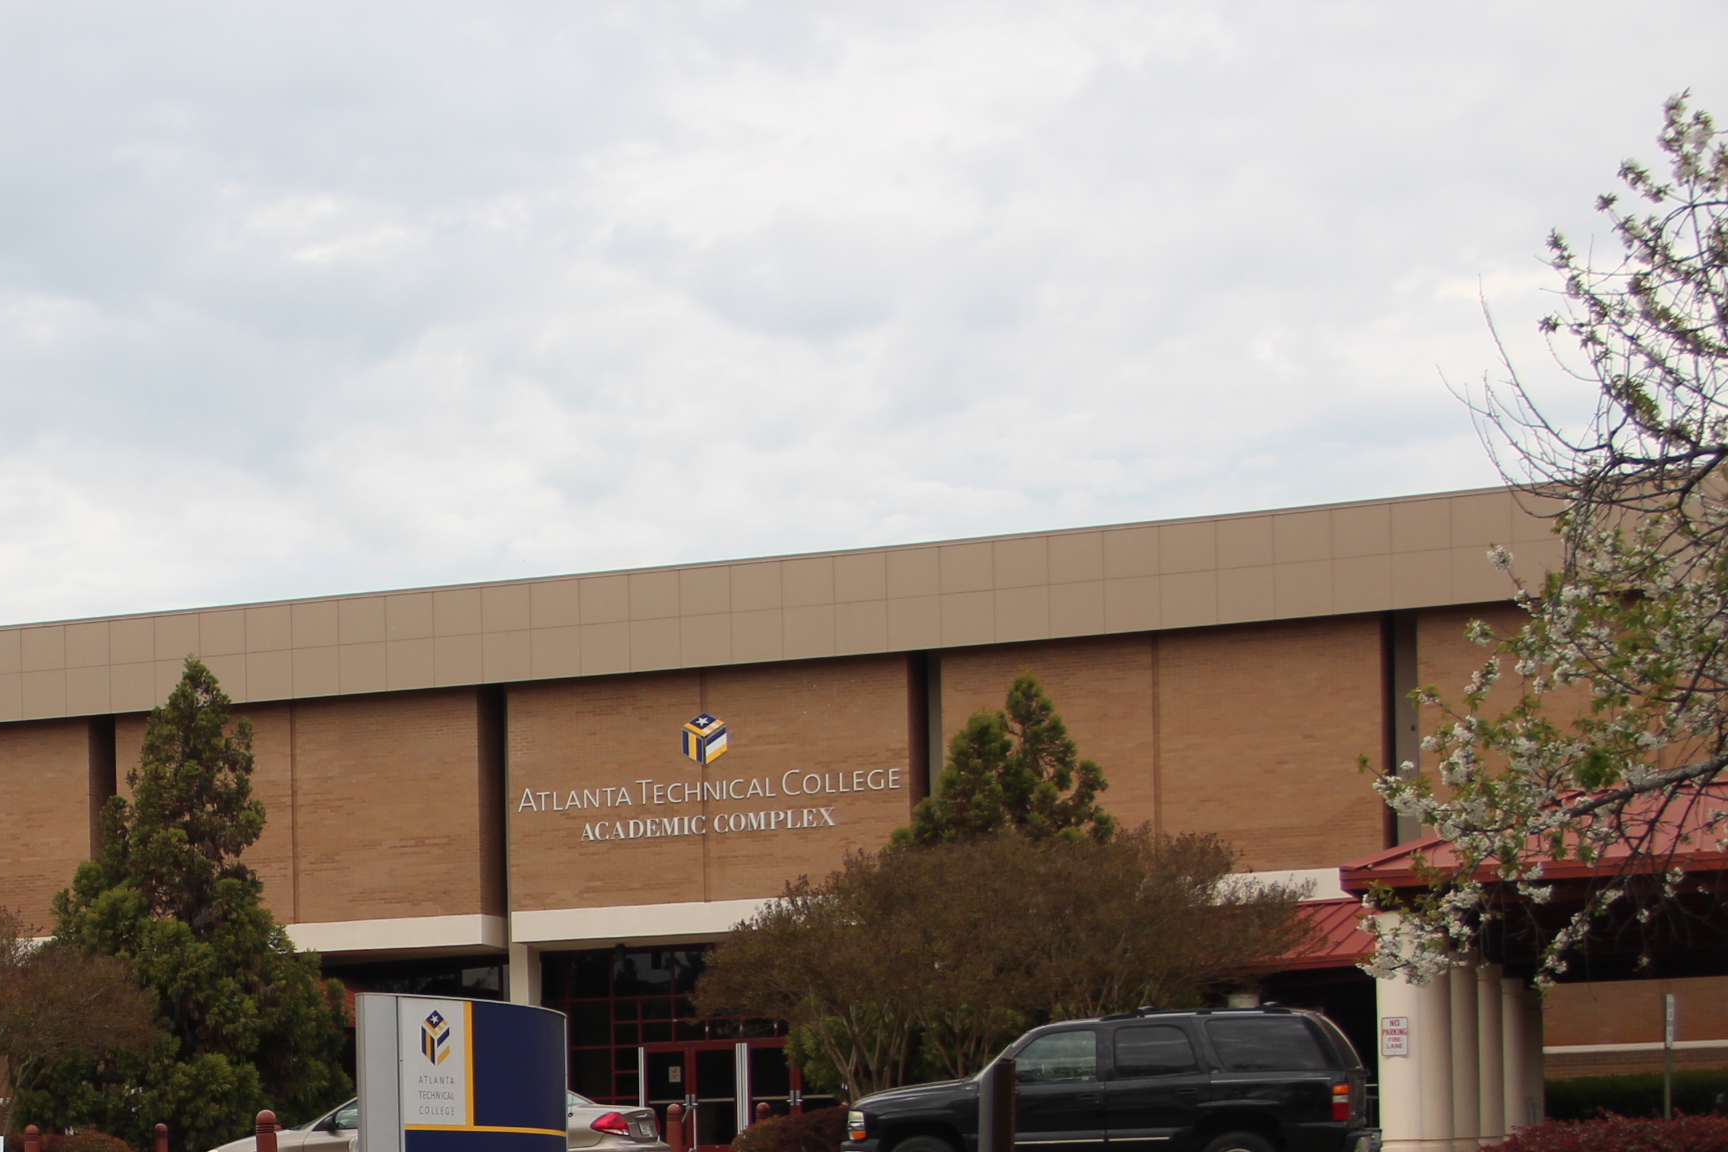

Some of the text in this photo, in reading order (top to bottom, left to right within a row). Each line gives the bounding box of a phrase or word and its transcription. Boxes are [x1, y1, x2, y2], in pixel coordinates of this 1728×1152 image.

[579, 806, 837, 842] ACADEMIC COMPLEX
[418, 1075, 455, 1085] ATLANTA
[418, 1090, 455, 1101] TECHNICAL
[418, 1105, 455, 1116] COLLEGE
